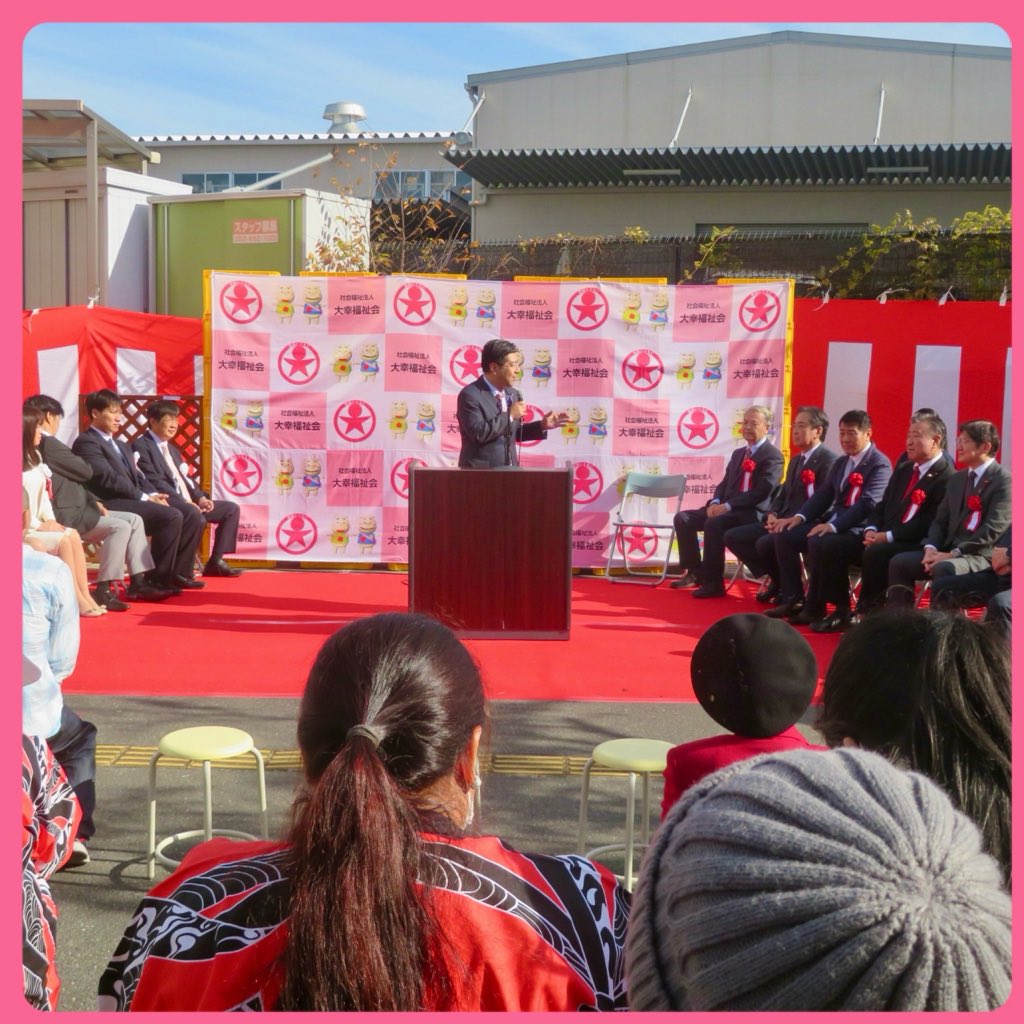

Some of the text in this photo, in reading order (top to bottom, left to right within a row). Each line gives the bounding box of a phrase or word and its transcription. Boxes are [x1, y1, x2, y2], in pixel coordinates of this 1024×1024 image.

[334, 305, 380, 316] 大幸福祉会
[506, 310, 553, 321] 大幸福祉会
[679, 313, 726, 324] 大幸福祉会
[224, 349, 259, 358] 社会福祉法人
[396, 352, 430, 360] 社会福祉法人
[218, 360, 265, 372] 大幸福祉会
[739, 357, 773, 365] 社会福祉法人
[390, 362, 437, 375] 大幸福祉会
[562, 368, 609, 379] 大幸福祉会
[733, 368, 779, 379] 大幸福祉会
[280, 409, 315, 417] 社会福祉法人
[625, 416, 659, 424] 社会福祉法人
[274, 421, 321, 431] 大幸福祉会
[618, 428, 664, 438] 大幸福祉会
[332, 478, 378, 488] 大幸福祉会
